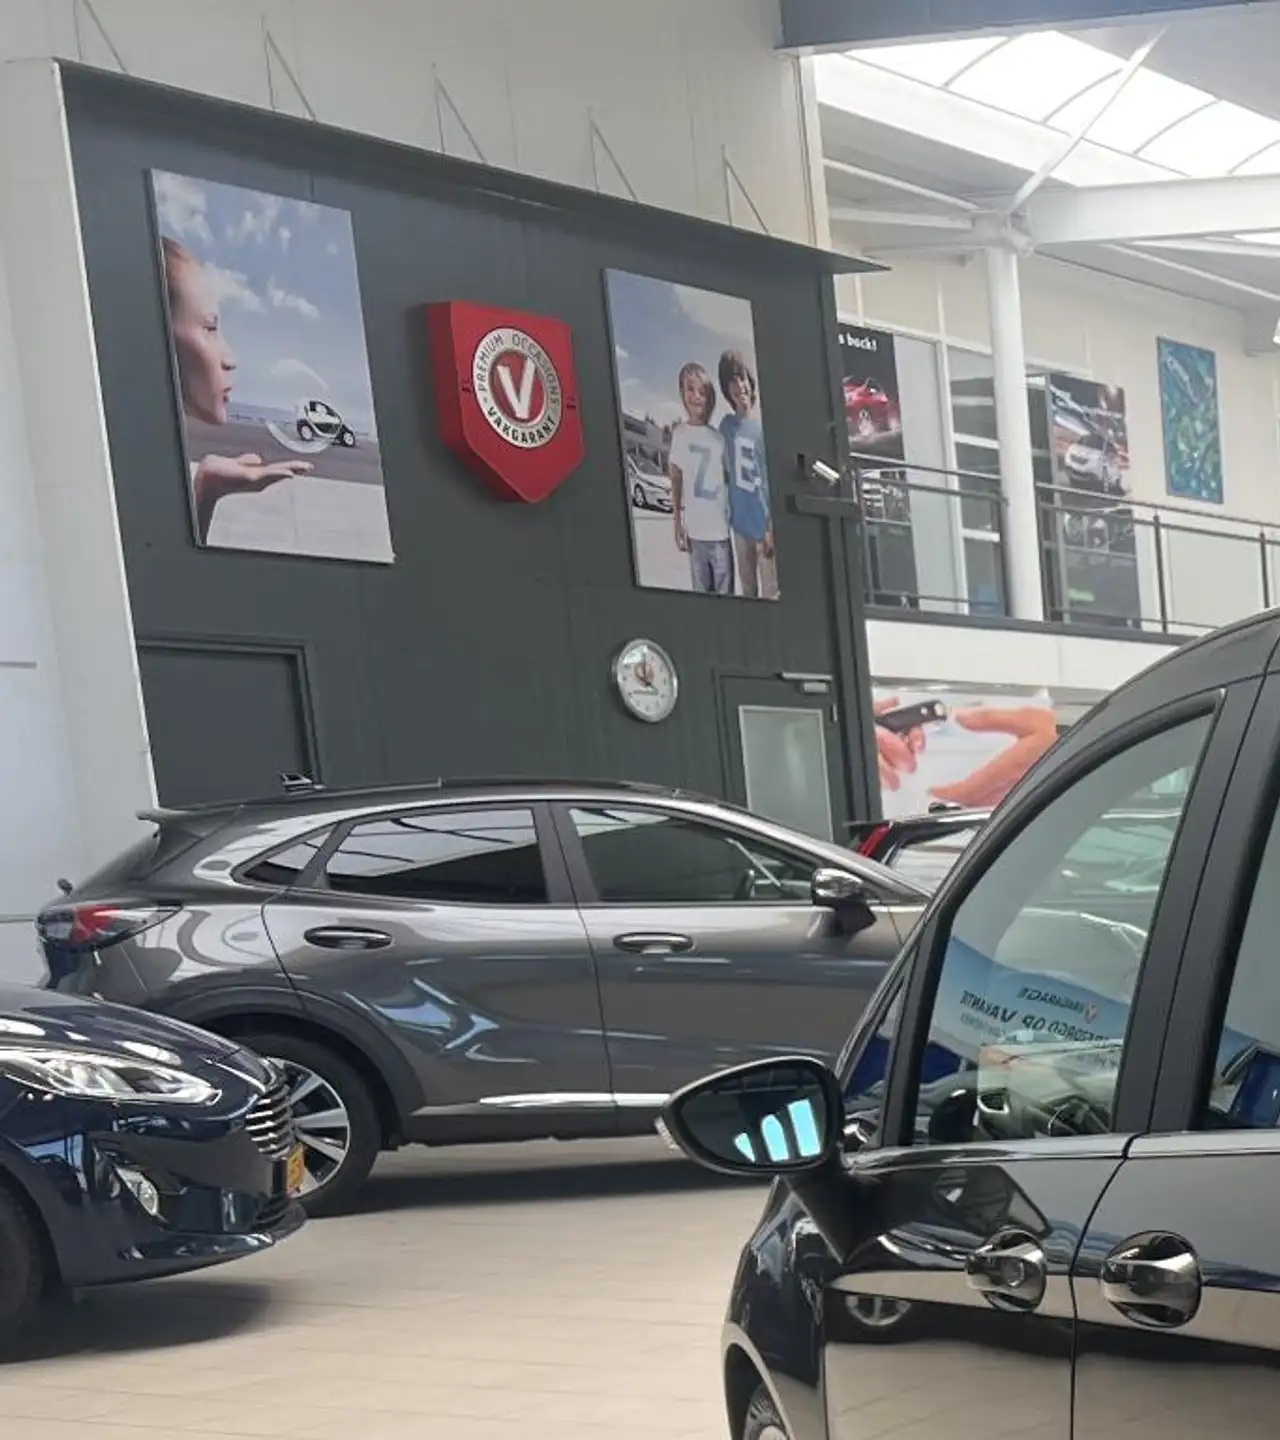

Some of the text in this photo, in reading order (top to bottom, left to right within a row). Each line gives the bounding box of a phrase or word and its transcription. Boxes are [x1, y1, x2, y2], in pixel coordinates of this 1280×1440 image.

[477, 333, 560, 405] PREMIUM OCCASIONS
[496, 356, 537, 419] V
[487, 406, 557, 444] VAKGARANT
